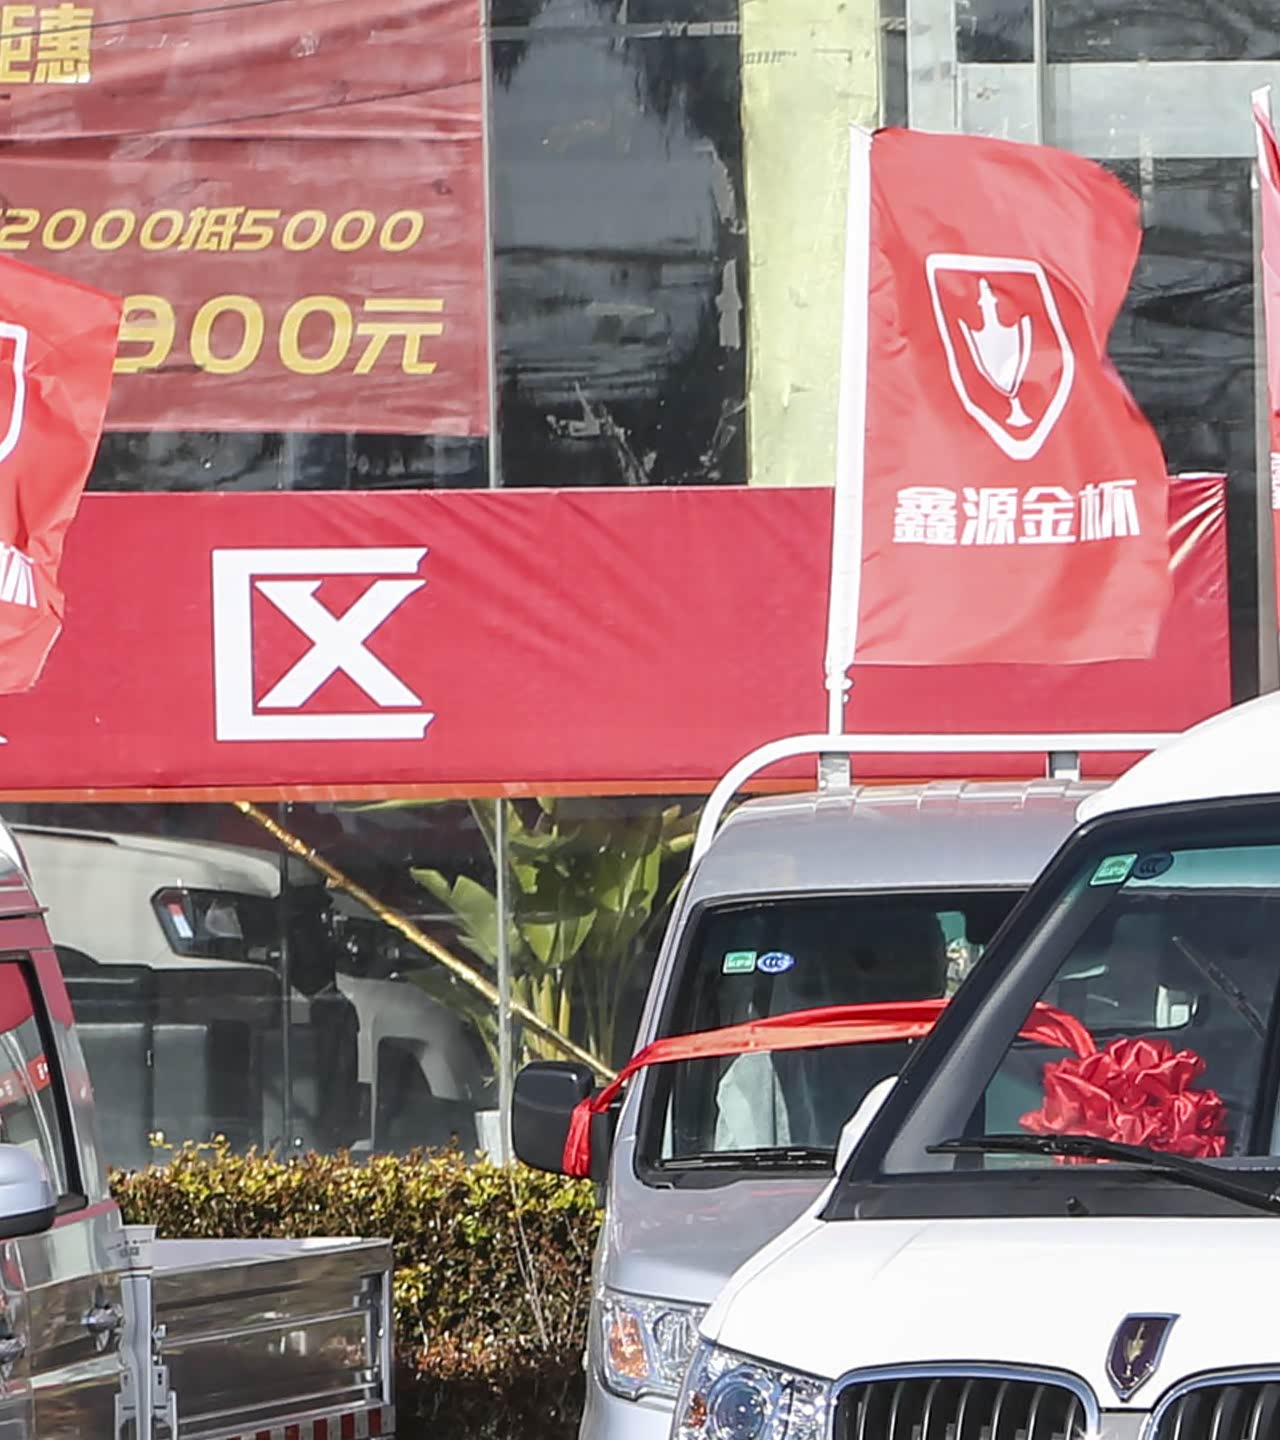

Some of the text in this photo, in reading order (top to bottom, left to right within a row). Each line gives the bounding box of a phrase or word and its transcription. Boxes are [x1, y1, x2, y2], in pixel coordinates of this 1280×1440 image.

[892, 479, 1140, 545] 鑫源金杯
[212, 547, 435, 742] 区
